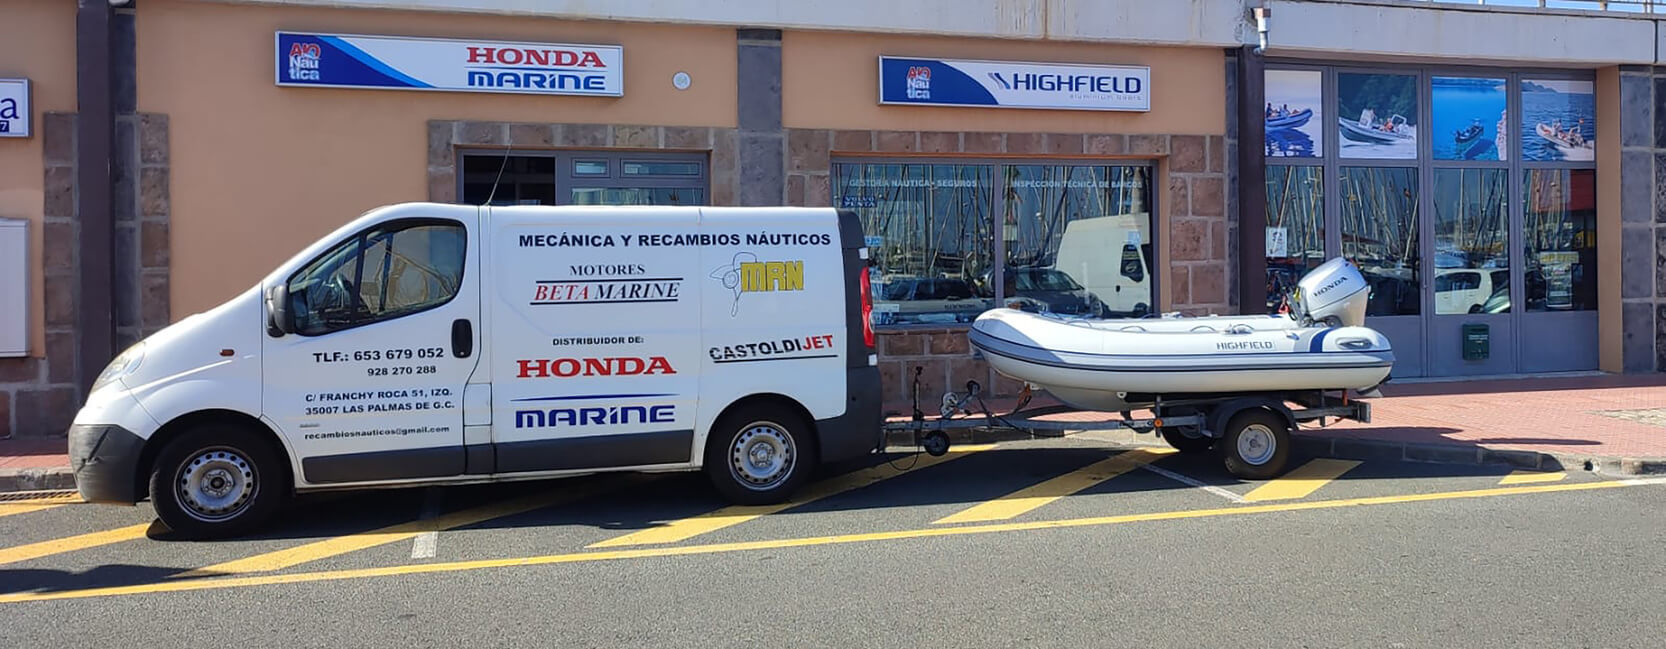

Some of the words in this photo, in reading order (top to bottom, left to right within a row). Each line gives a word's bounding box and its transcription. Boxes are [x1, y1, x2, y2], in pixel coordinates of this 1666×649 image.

[466, 46, 607, 68] HONDA
[289, 69, 320, 80] tica
[467, 71, 606, 90] MARINE
[1012, 73, 1142, 94] HIGHFIELD
[937, 179, 977, 187] SEGUROS
[518, 232, 615, 247] MECÁNICA
[620, 234, 633, 246] Y
[638, 233, 740, 247] RECAMBIOS
[746, 230, 831, 246] NÁUTICOS
[569, 264, 645, 276] MOTORES
[740, 260, 804, 292] MRN
[533, 284, 589, 301] BETA
[594, 282, 680, 300] MARINE
[1313, 276, 1348, 297] HONDA
[552, 337, 626, 346] DISTRIBUIDOR
[628, 336, 644, 344] DE:
[1216, 341, 1273, 350] HIGHFIELD
[312, 352, 349, 363] TLF.:
[354, 351, 381, 361] 653
[386, 349, 413, 360] 679
[418, 347, 444, 358] 052
[367, 367, 388, 376] 928
[392, 366, 413, 375] 270
[416, 365, 436, 374] 288
[516, 356, 677, 378] HONDA
[305, 393, 317, 402] C/
[320, 391, 374, 401] FRANCHY
[377, 390, 408, 399] ROCA
[411, 389, 428, 398] 51,
[431, 388, 452, 397] IZQ.
[305, 406, 339, 415] 35007
[343, 405, 364, 413] LAS
[368, 403, 412, 412] PALMAS
[415, 402, 430, 410] DE
[433, 401, 455, 409] G.C.
[515, 405, 676, 428] MARINE
[304, 426, 450, 440] recambiosnauticos@gmail.com
